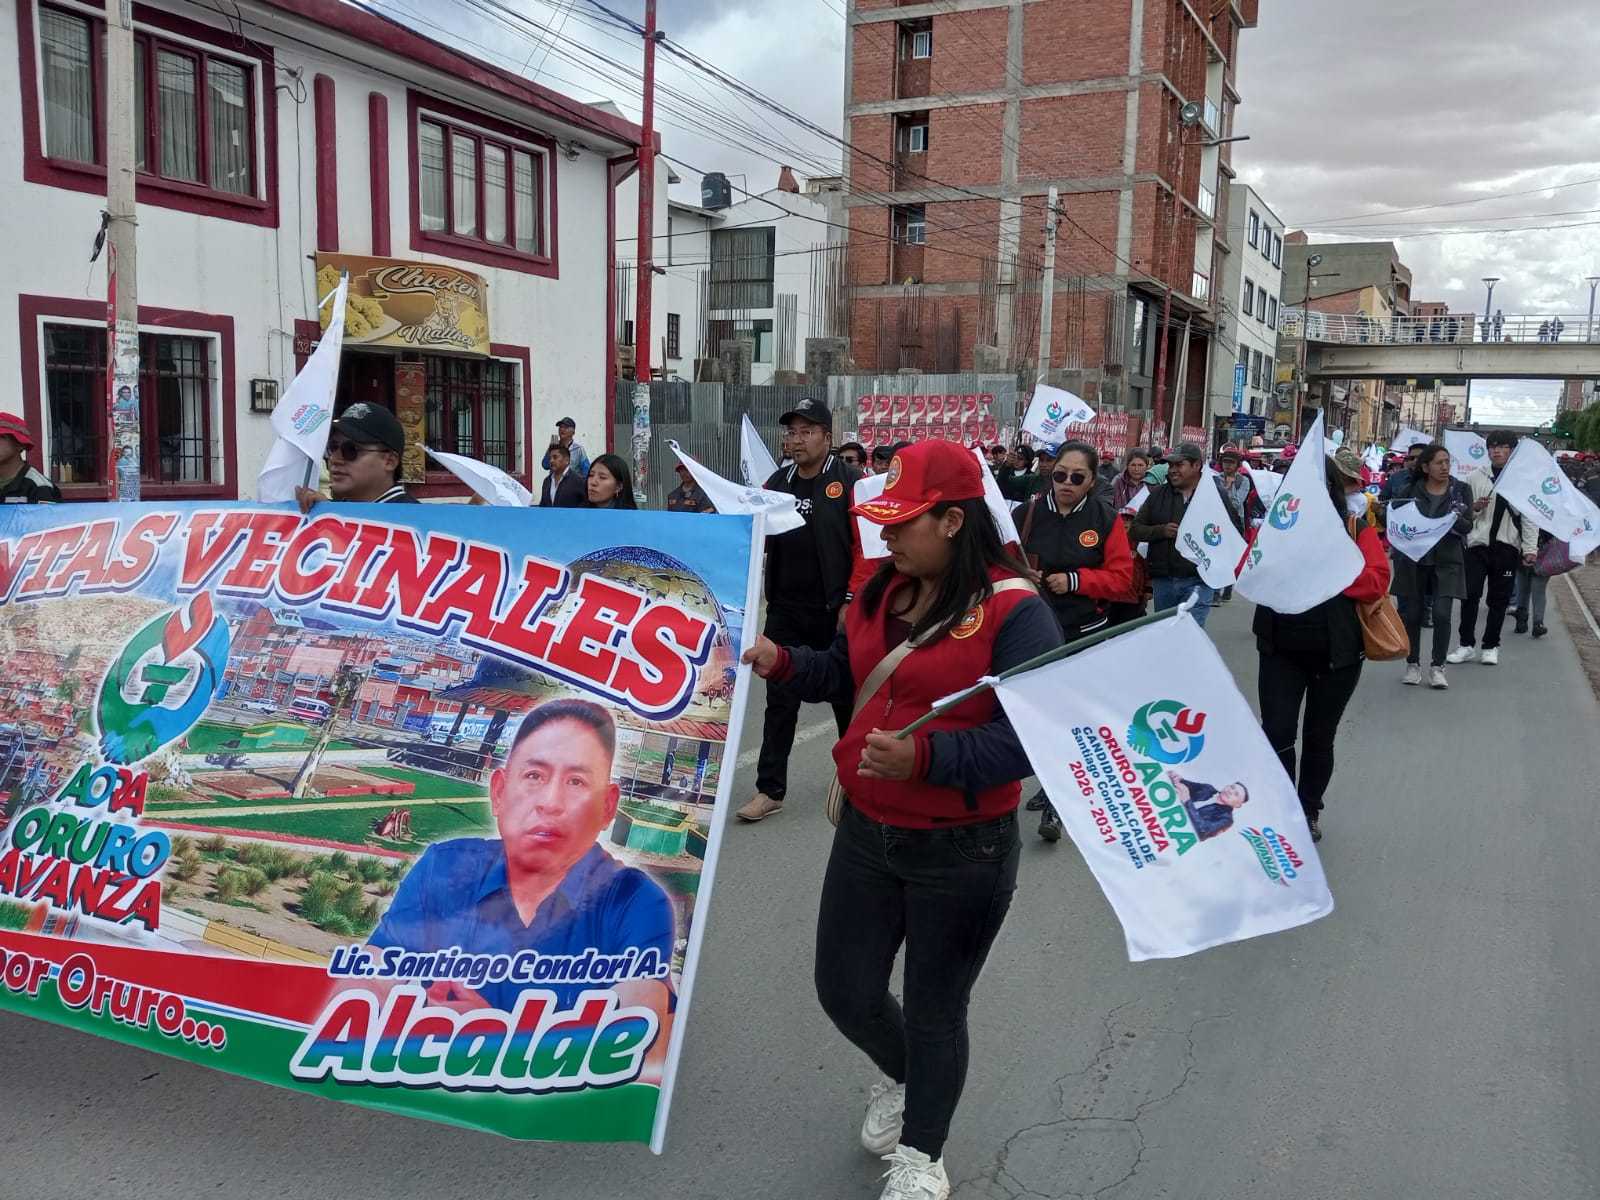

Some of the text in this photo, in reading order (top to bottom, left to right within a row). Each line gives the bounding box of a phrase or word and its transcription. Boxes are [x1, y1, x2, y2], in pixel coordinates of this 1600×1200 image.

[376, 265, 478, 299] Chicken
[1528, 494, 1554, 517] AORA
[1183, 532, 1211, 572] AORA
[178, 510, 716, 721] VECINALES
[55, 762, 149, 818] AORA
[1069, 761, 1095, 797] 2026
[1090, 807, 1117, 844] 2031
[1071, 727, 1144, 870] Santiago Condori Apaza
[1083, 726, 1157, 863] CANDIDATO ALCALDE
[1098, 726, 1169, 853] ORURO AVANZA
[1133, 762, 1198, 856] AORA
[11, 807, 171, 880] ORURO
[1263, 827, 1296, 878] ORURO
[1276, 832, 1304, 868] AORA
[0, 848, 160, 932] AVANZA
[329, 946, 669, 986] Lic. Santiago Condori A.
[290, 988, 660, 1090] Alcalde
